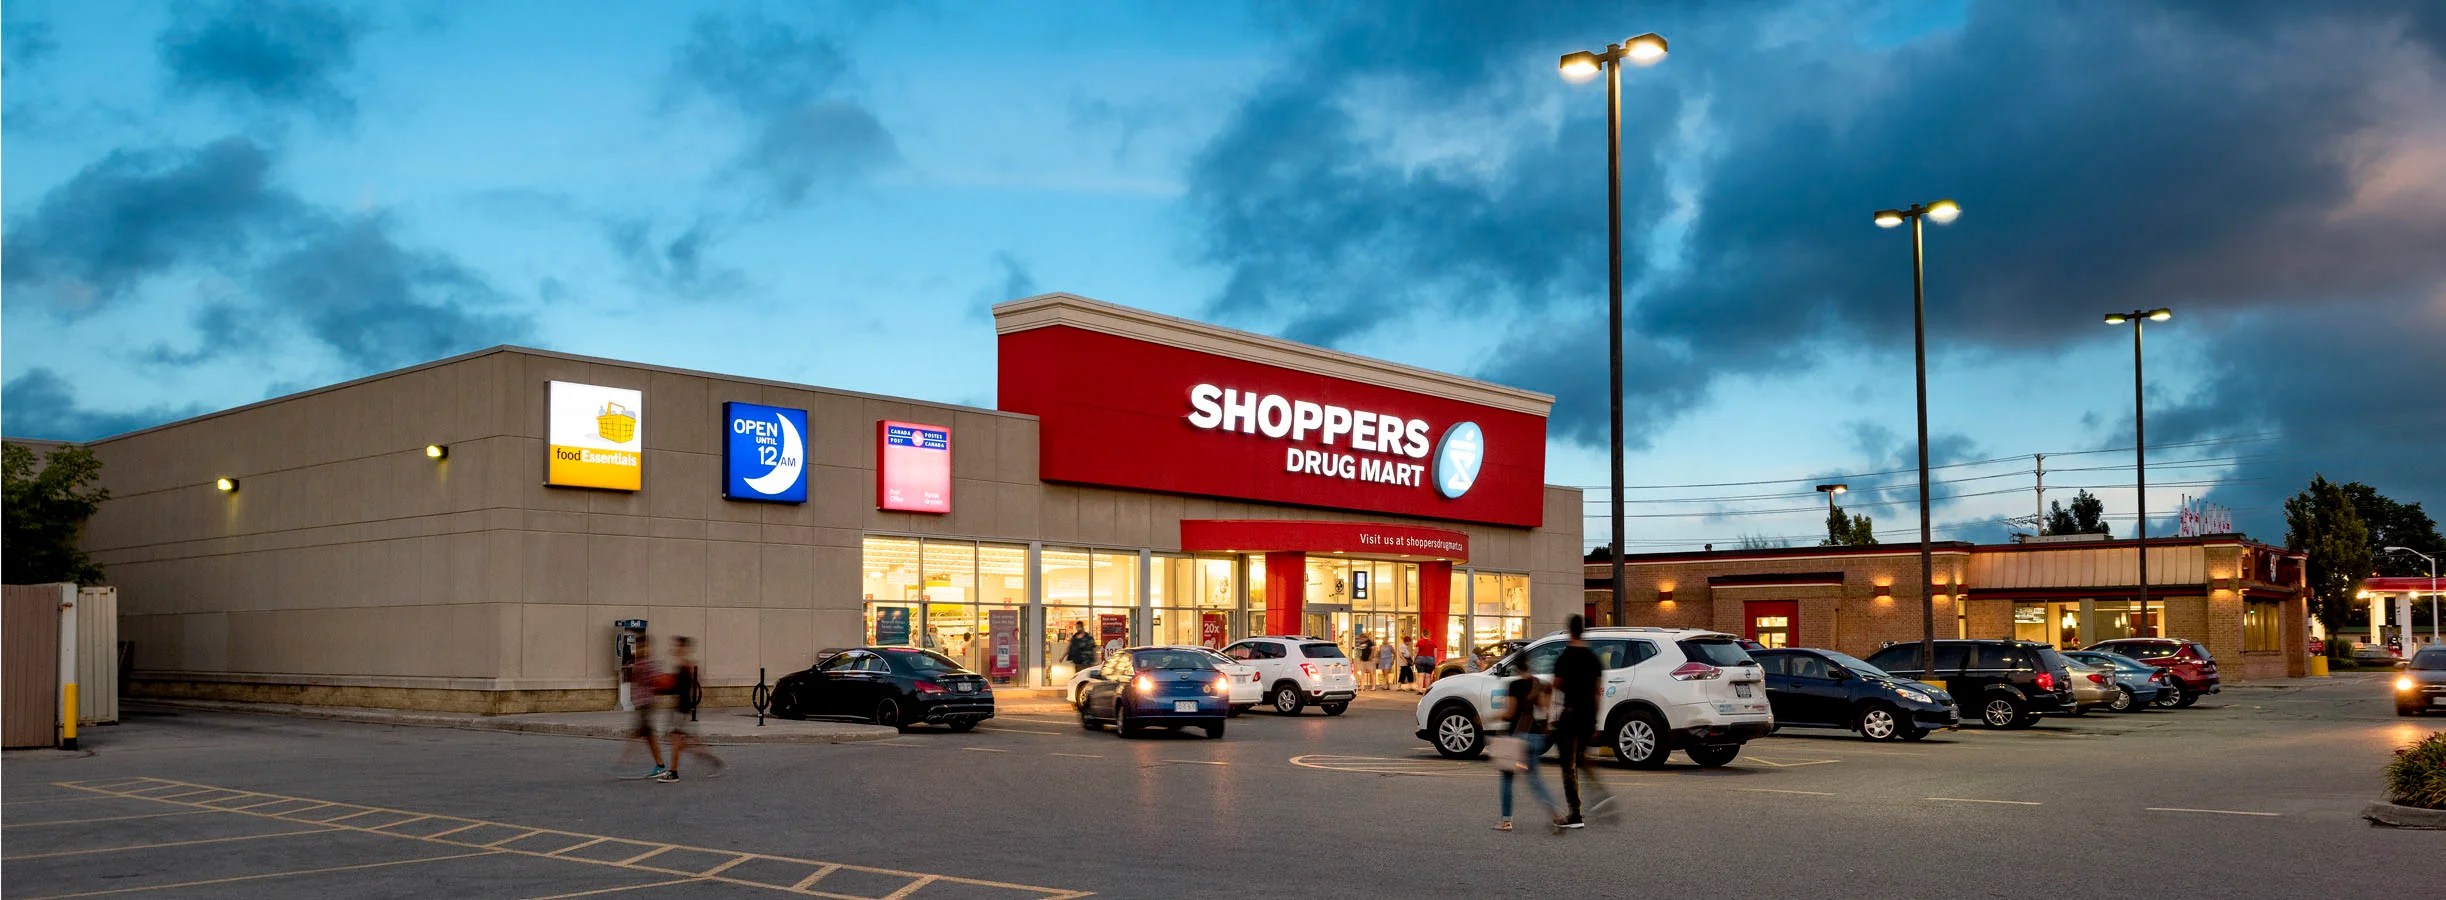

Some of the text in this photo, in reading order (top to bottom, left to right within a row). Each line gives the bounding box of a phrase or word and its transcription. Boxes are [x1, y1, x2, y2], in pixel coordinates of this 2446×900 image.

[733, 418, 778, 438] OPEN
[1188, 383, 1430, 459] SHOPPERS
[755, 436, 778, 445] UNTIL
[556, 448, 637, 467] food Essentials
[757, 445, 796, 467] 12 AM
[1286, 447, 1425, 487] DRUG MART
[1360, 533, 1463, 552] Visit us at shoppersdrugmart.ca
[1204, 623, 1220, 634] 20x
